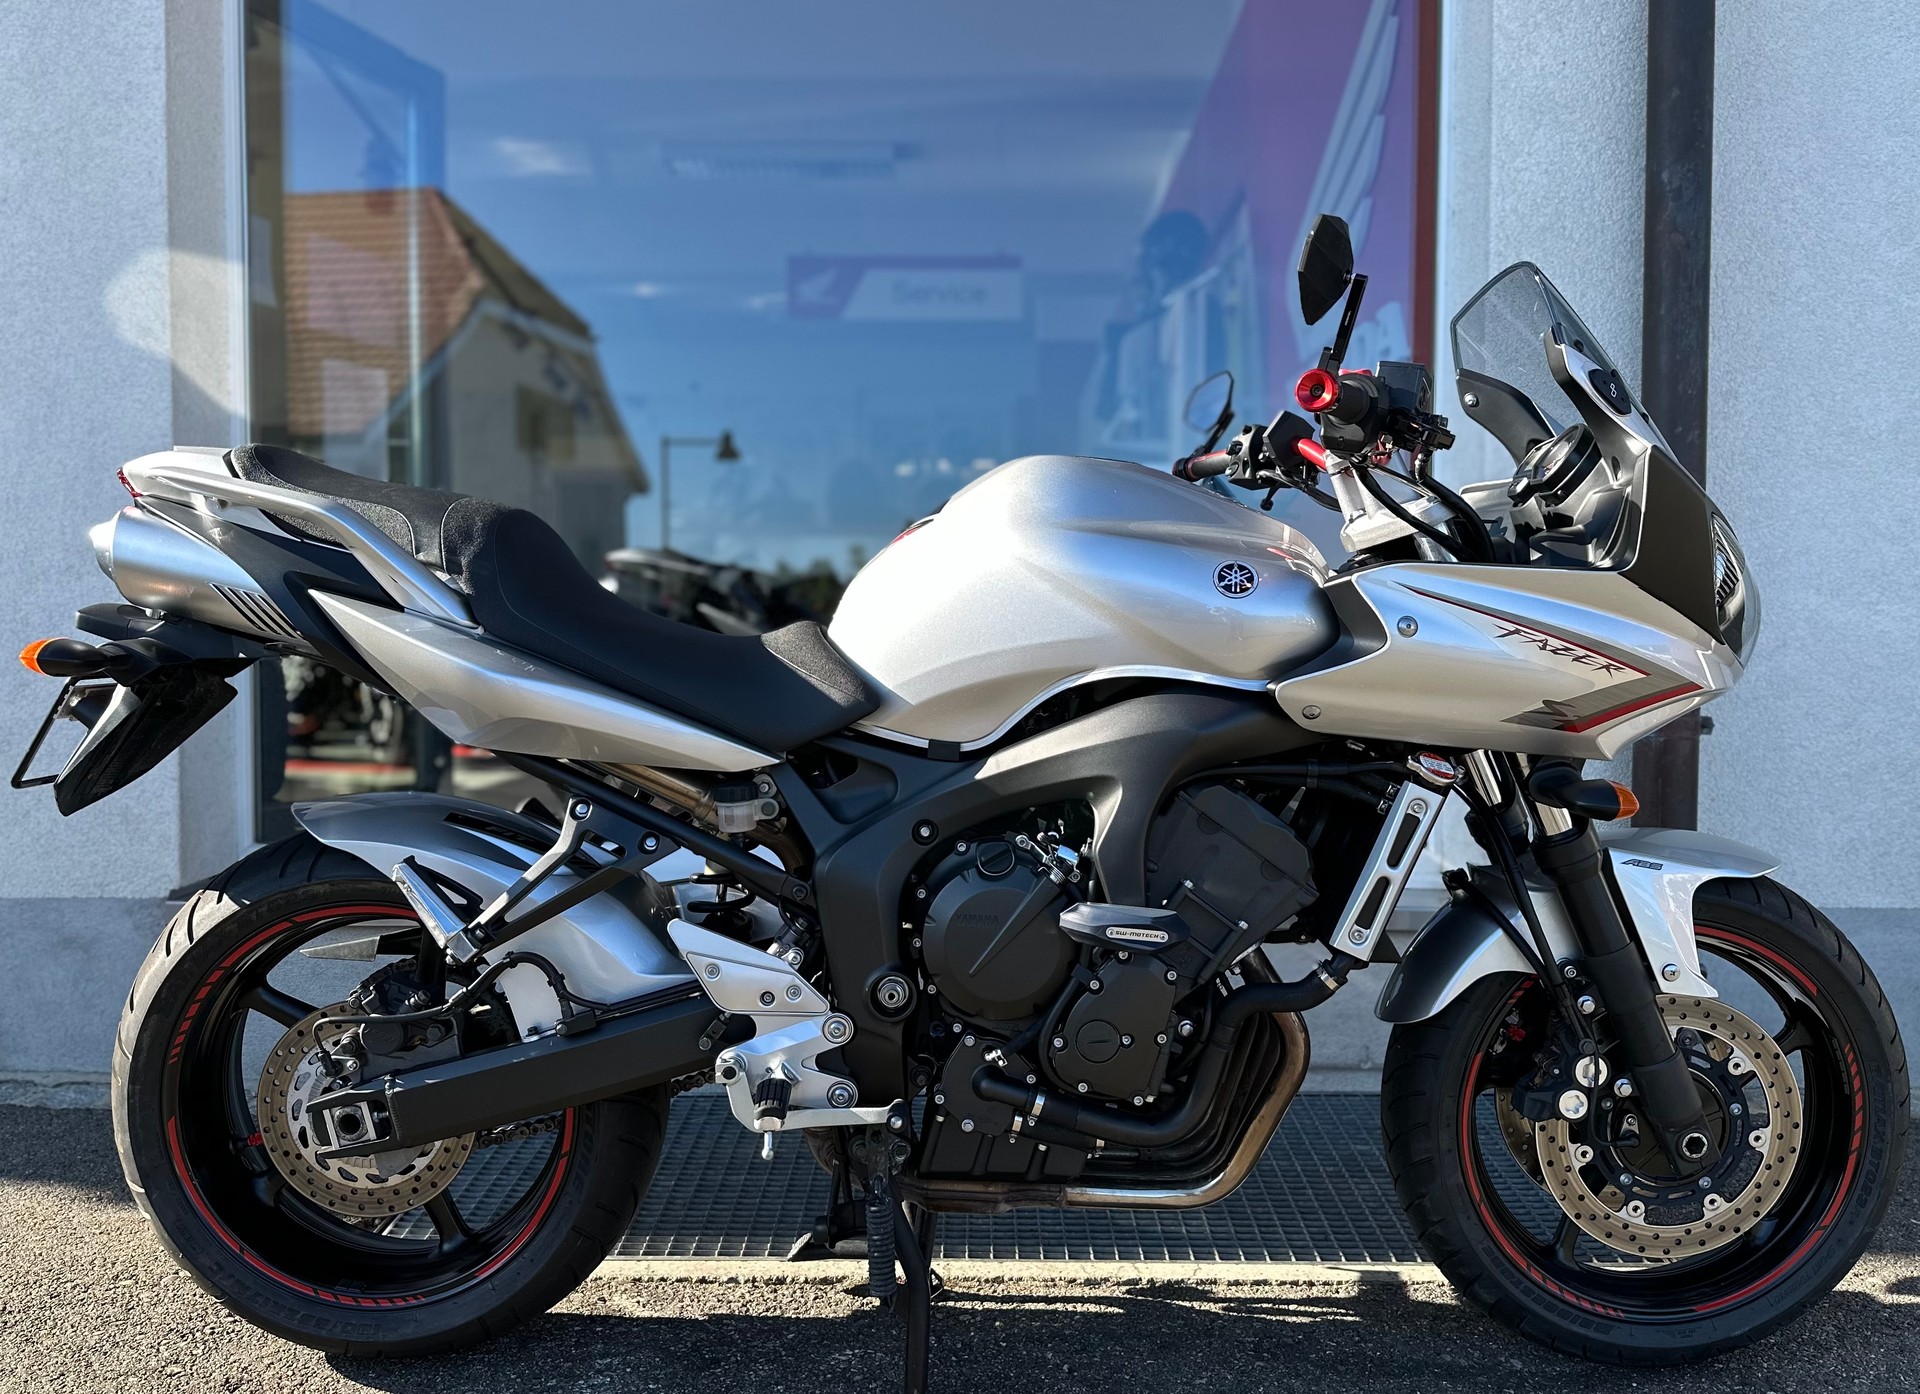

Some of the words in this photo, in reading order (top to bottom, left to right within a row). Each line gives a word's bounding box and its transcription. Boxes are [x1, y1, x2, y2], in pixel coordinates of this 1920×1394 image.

[890, 278, 988, 305] Service
[1493, 623, 1628, 678] FAZER
[1620, 858, 1664, 871] ABS
[956, 913, 999, 928] YAMAHA
[1115, 931, 1160, 939] SW-MOTECH
